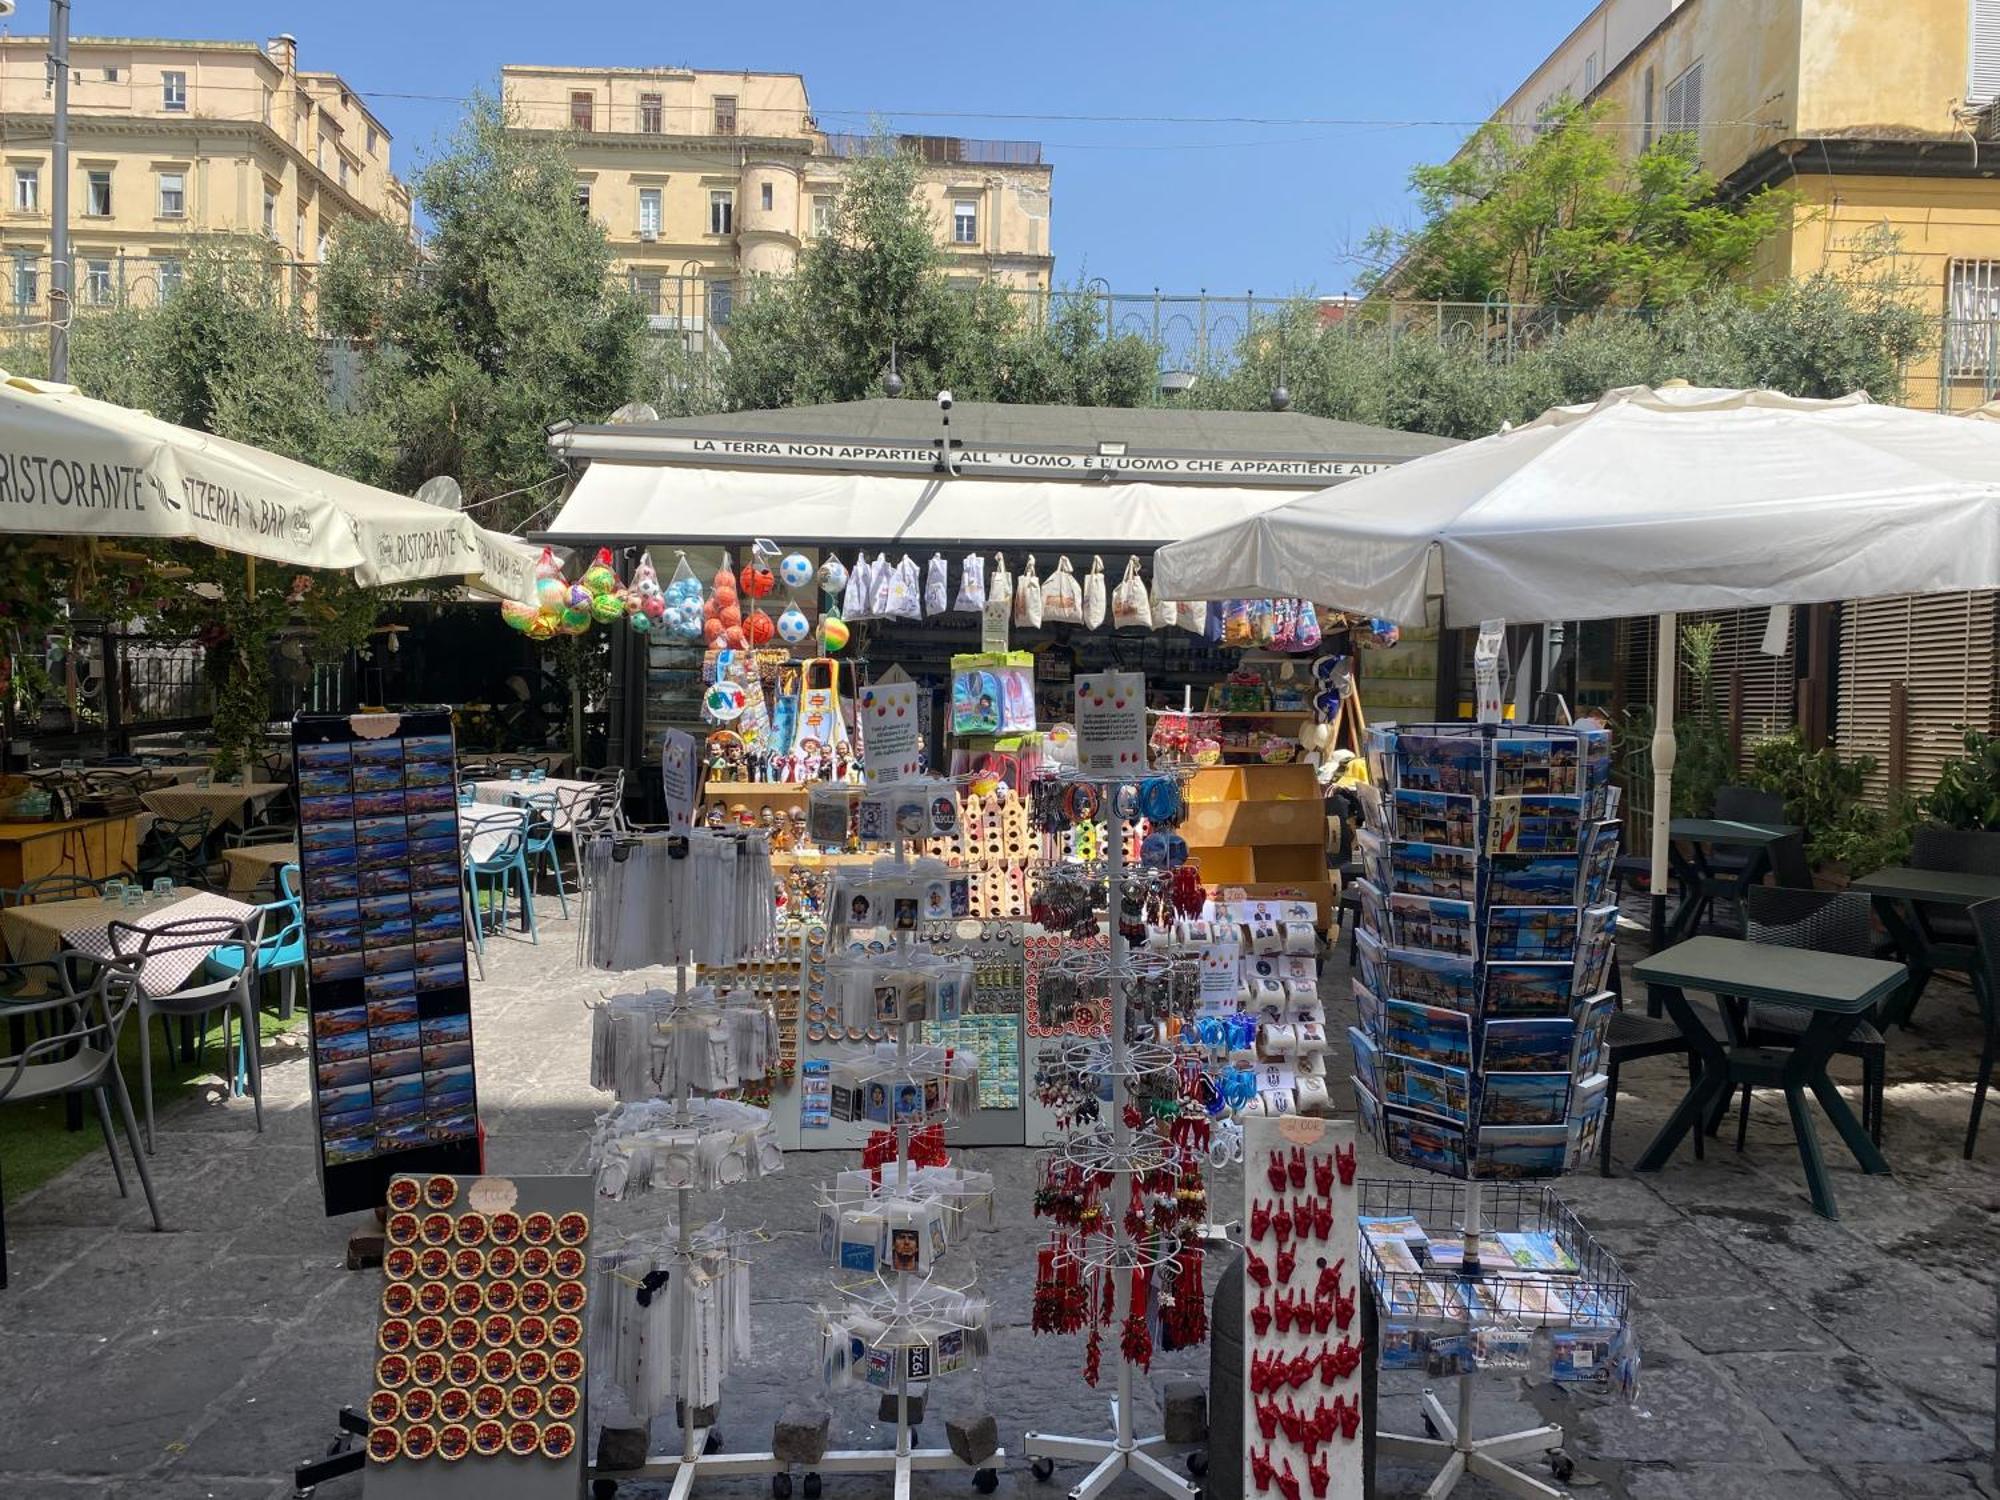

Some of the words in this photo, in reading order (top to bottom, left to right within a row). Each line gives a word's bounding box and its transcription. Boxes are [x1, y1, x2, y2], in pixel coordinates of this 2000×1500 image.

[693, 440, 716, 451] LA
[723, 441, 781, 455] TERRA
[788, 444, 833, 457] NON
[839, 447, 942, 462] APPARTIEN
[1186, 460, 1224, 472] CHE
[1229, 461, 1343, 475] APPARTIENE
[0, 452, 146, 512] RISTORANTE
[260, 499, 286, 539] BAR
[397, 528, 456, 565] RISTORANTE
